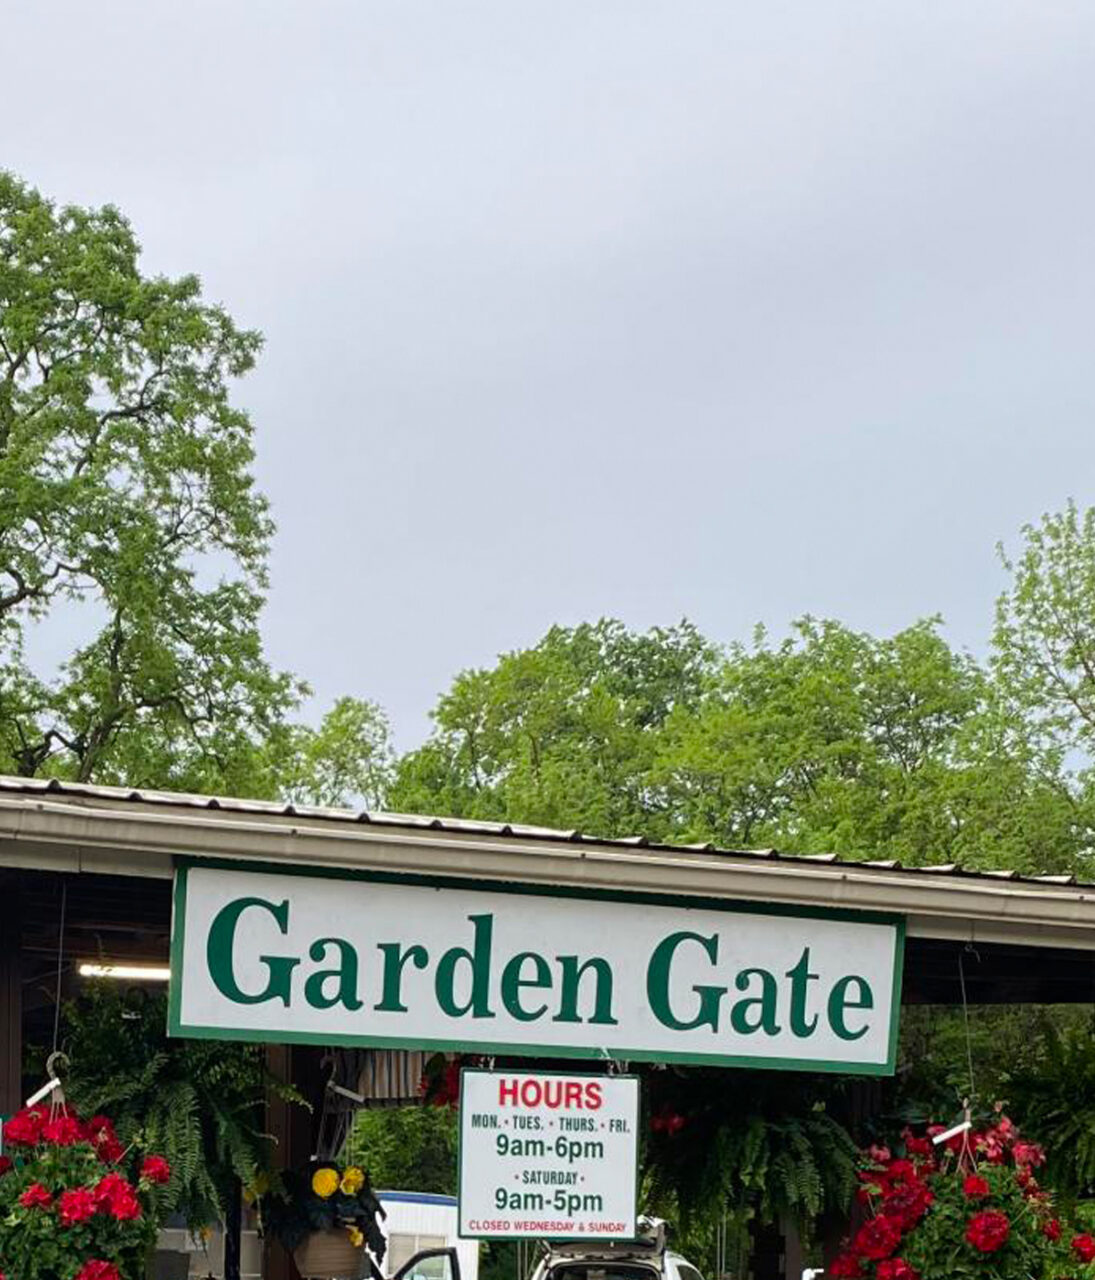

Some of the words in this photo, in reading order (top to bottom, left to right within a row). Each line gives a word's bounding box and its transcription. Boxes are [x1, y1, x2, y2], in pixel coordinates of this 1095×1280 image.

[206, 896, 619, 1026] Garden
[646, 931, 874, 1041] Gate
[499, 1079, 603, 1110] HOURS
[471, 1114, 502, 1129] MON.
[513, 1115, 544, 1131] TUES.
[559, 1117, 598, 1132] THURS.
[609, 1119, 630, 1133] FRI.
[496, 1133, 604, 1163] 9am-6pm
[522, 1170, 578, 1185] SATURDAY
[495, 1187, 603, 1217] 9am-5pm
[469, 1220, 511, 1231] CLOSED
[514, 1221, 575, 1232] WEDNESDAY
[589, 1222, 626, 1233] SUNDAY
